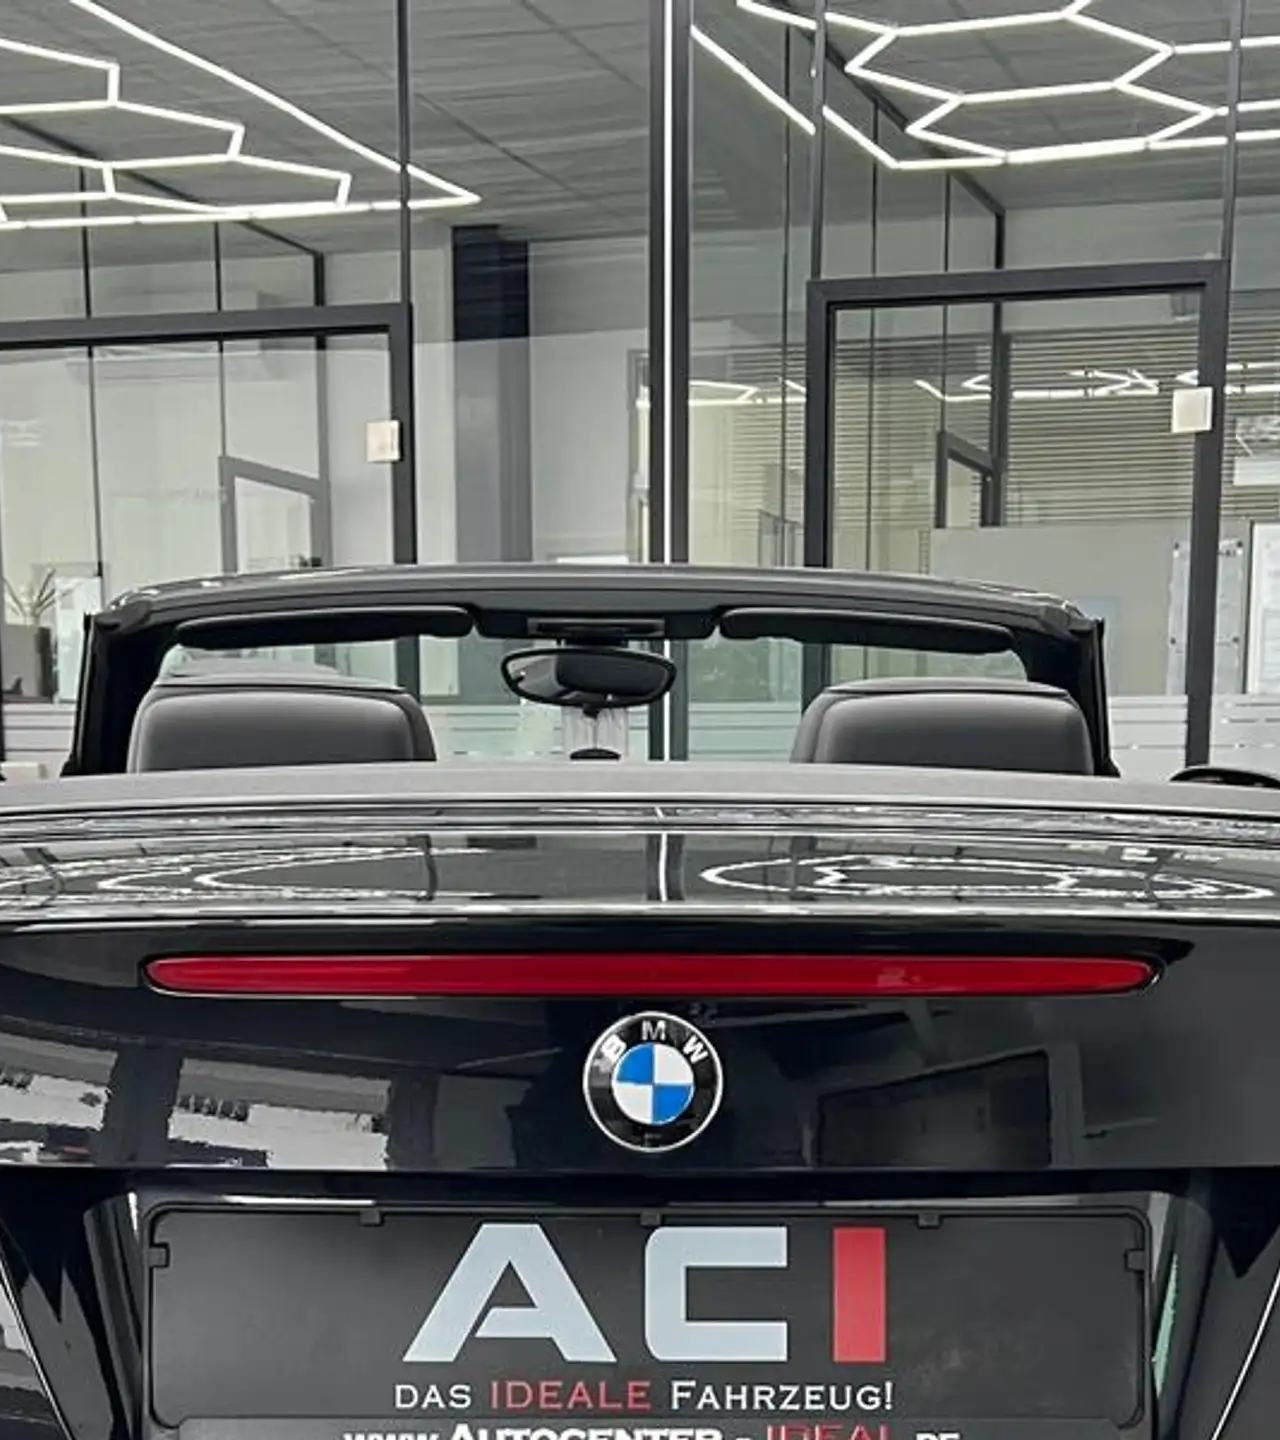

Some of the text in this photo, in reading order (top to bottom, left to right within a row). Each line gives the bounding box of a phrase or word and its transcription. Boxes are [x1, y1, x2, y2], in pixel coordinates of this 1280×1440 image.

[600, 1020, 708, 1065] BMW
[402, 1223, 887, 1363] ACI
[394, 1379, 893, 1411] DAS IDEALE FAHRZEUG!
